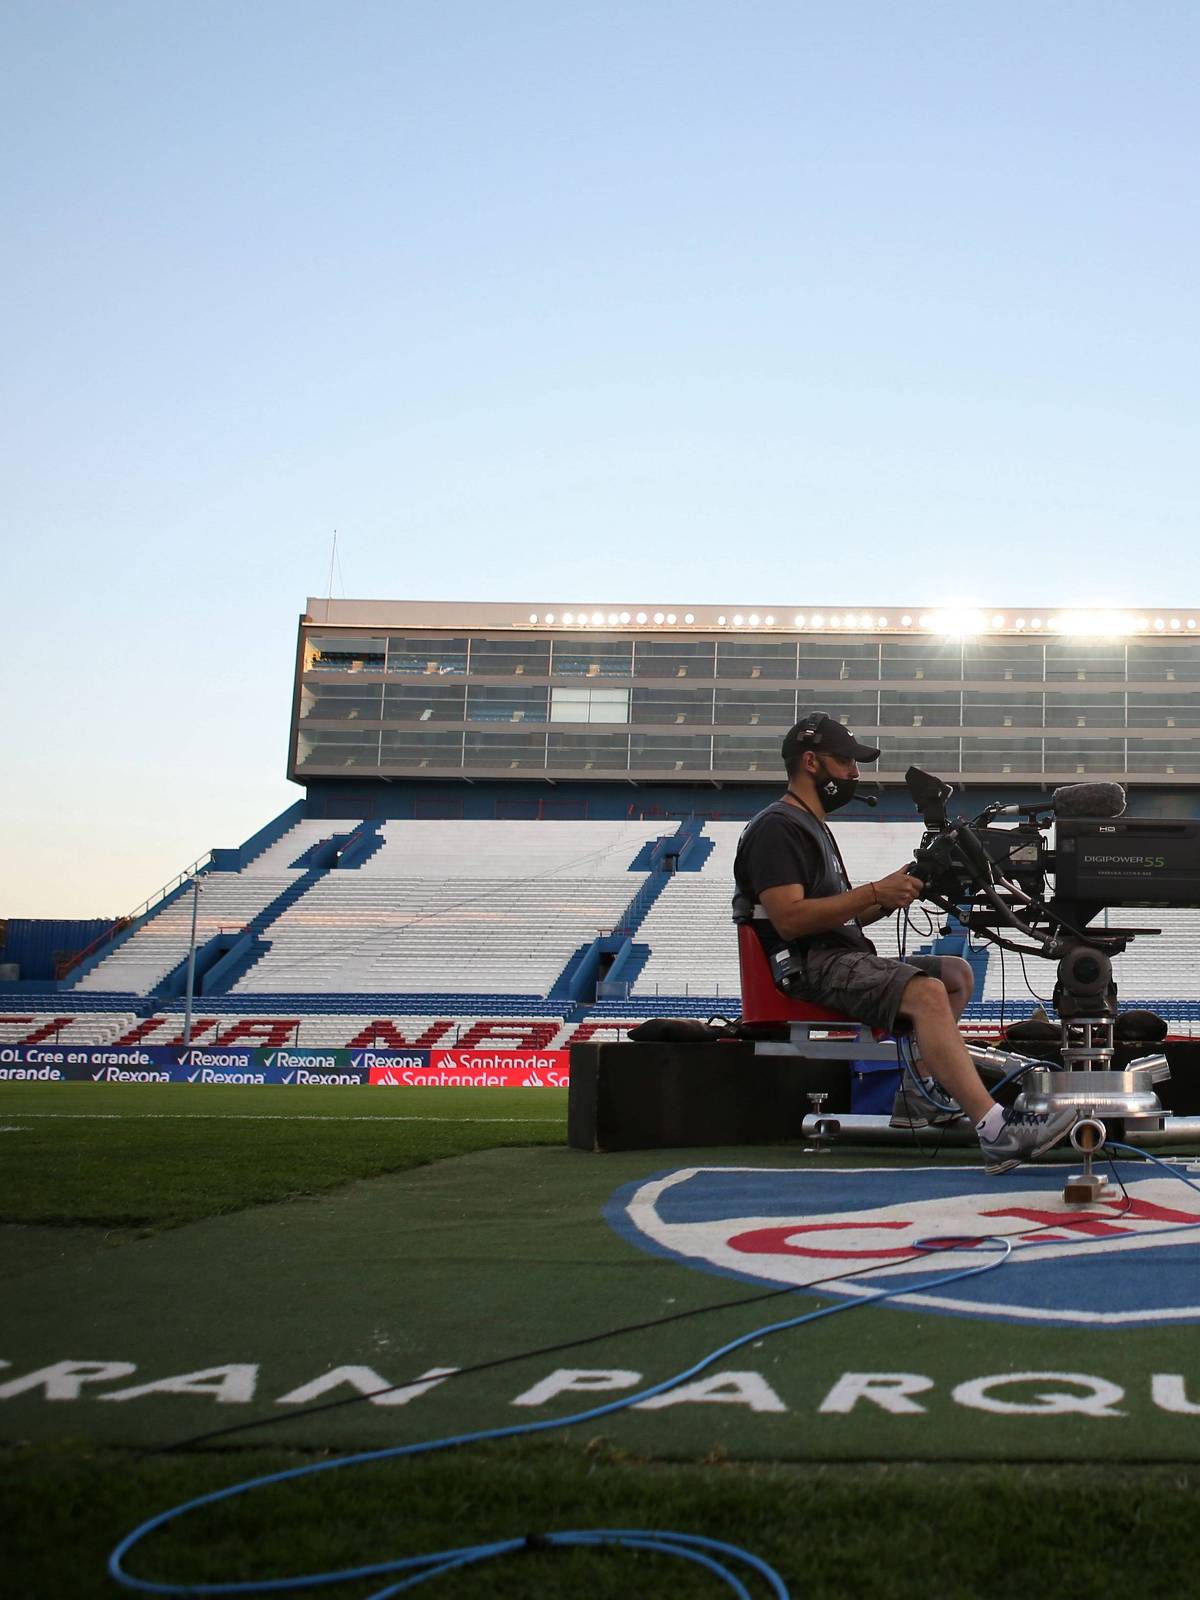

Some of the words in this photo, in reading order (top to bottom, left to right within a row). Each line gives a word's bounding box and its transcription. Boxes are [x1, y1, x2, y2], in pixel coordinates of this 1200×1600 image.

[26, 1050, 64, 1063] Cree
[67, 1053, 88, 1064] en
[190, 1051, 249, 1067] Rexona
[277, 1052, 335, 1068] Rexona
[363, 1053, 423, 1067] Rexona
[460, 1054, 557, 1068] Santander
[106, 1068, 170, 1082] Rexona
[201, 1069, 265, 1084] Rexona
[297, 1070, 361, 1085] Rexona
[402, 1071, 508, 1086] Santander
[0, 1358, 464, 1406] RAN
